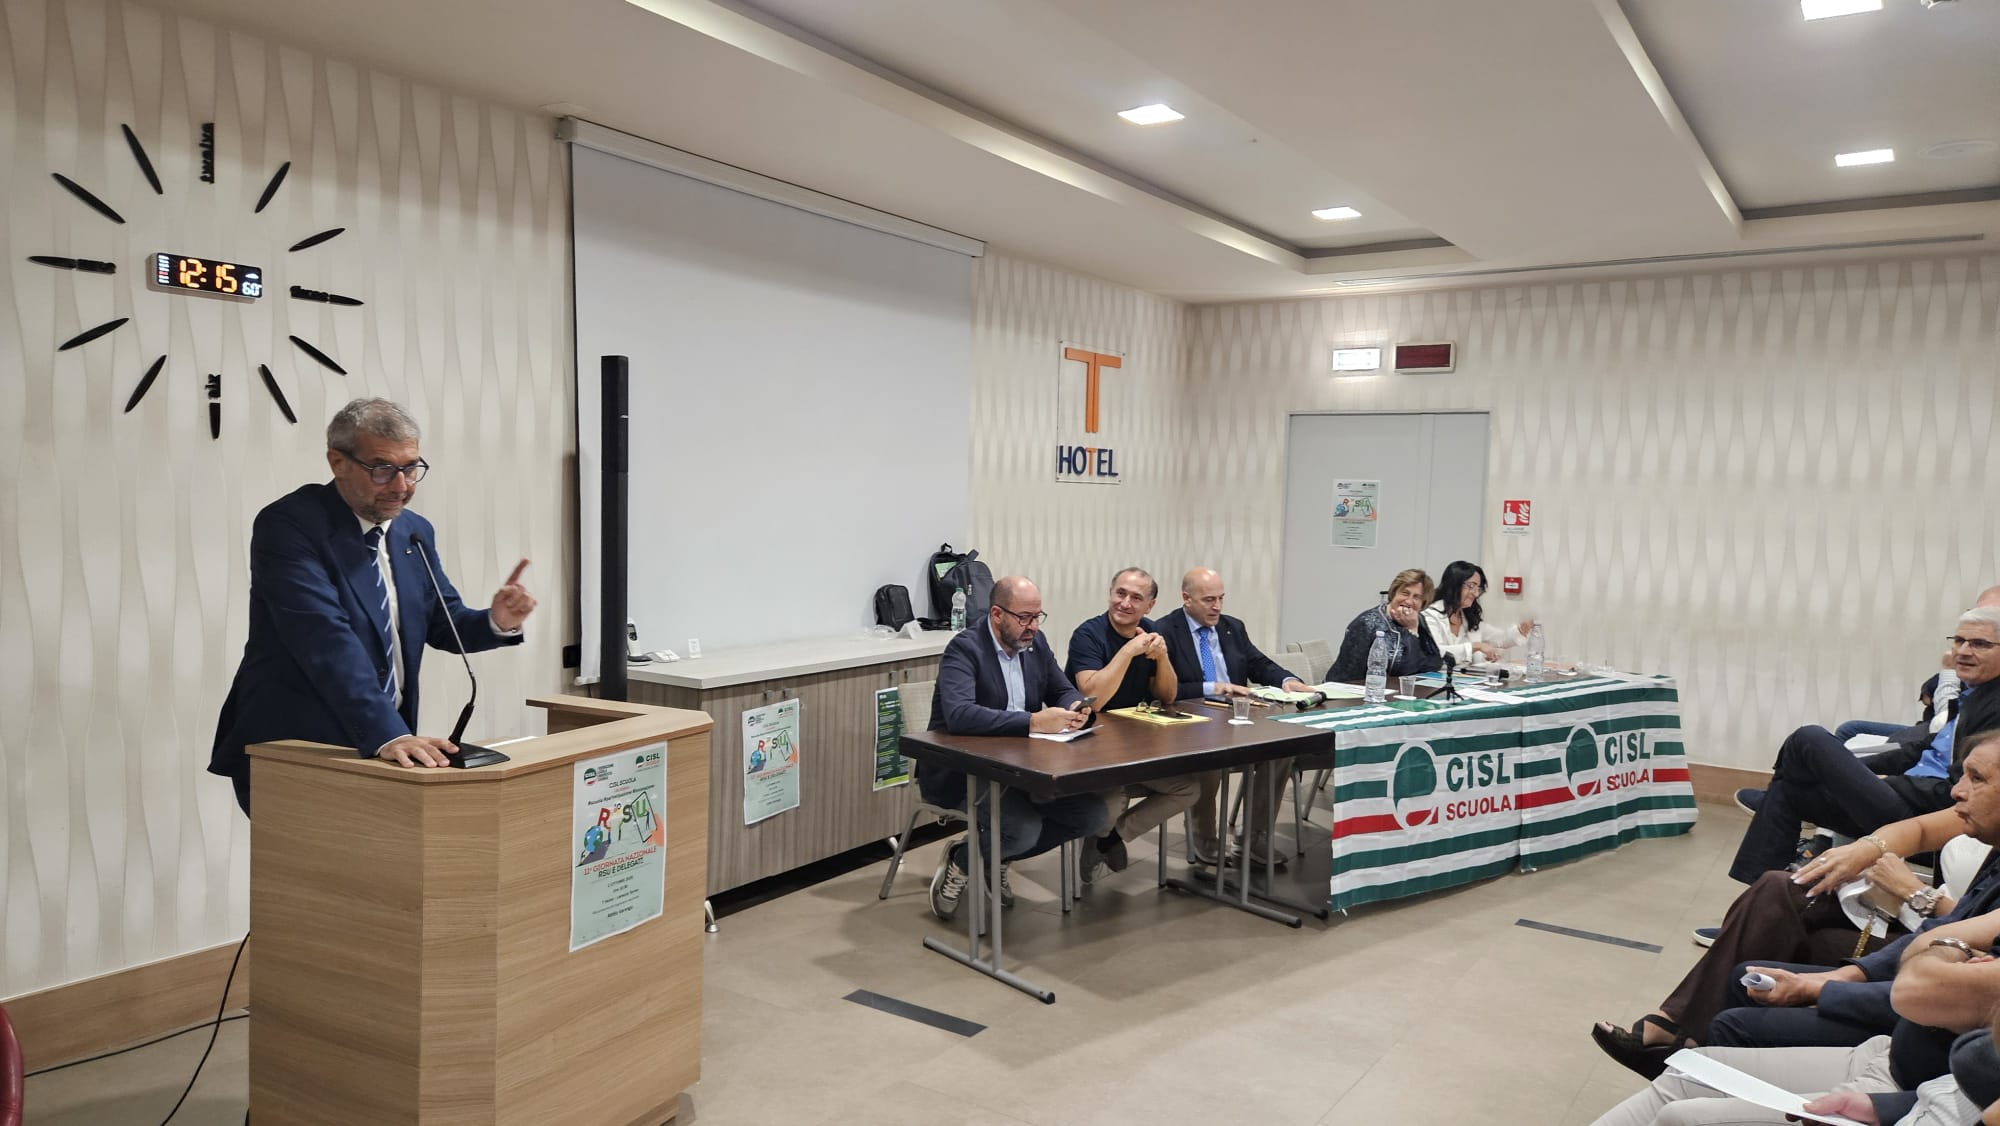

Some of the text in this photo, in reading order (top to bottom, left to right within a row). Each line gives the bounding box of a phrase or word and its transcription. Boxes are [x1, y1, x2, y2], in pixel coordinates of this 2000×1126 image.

[180, 258, 237, 293] 12:15
[1064, 347, 1122, 433] T
[1059, 445, 1119, 476] HOTEL
[646, 752, 660, 761] CISL
[1604, 732, 1651, 766] CISL
[1446, 752, 1511, 792] CISL
[1446, 794, 1512, 821] SCUOLA
[593, 857, 625, 872] GIORNATA
[598, 868, 611, 877] RSU
